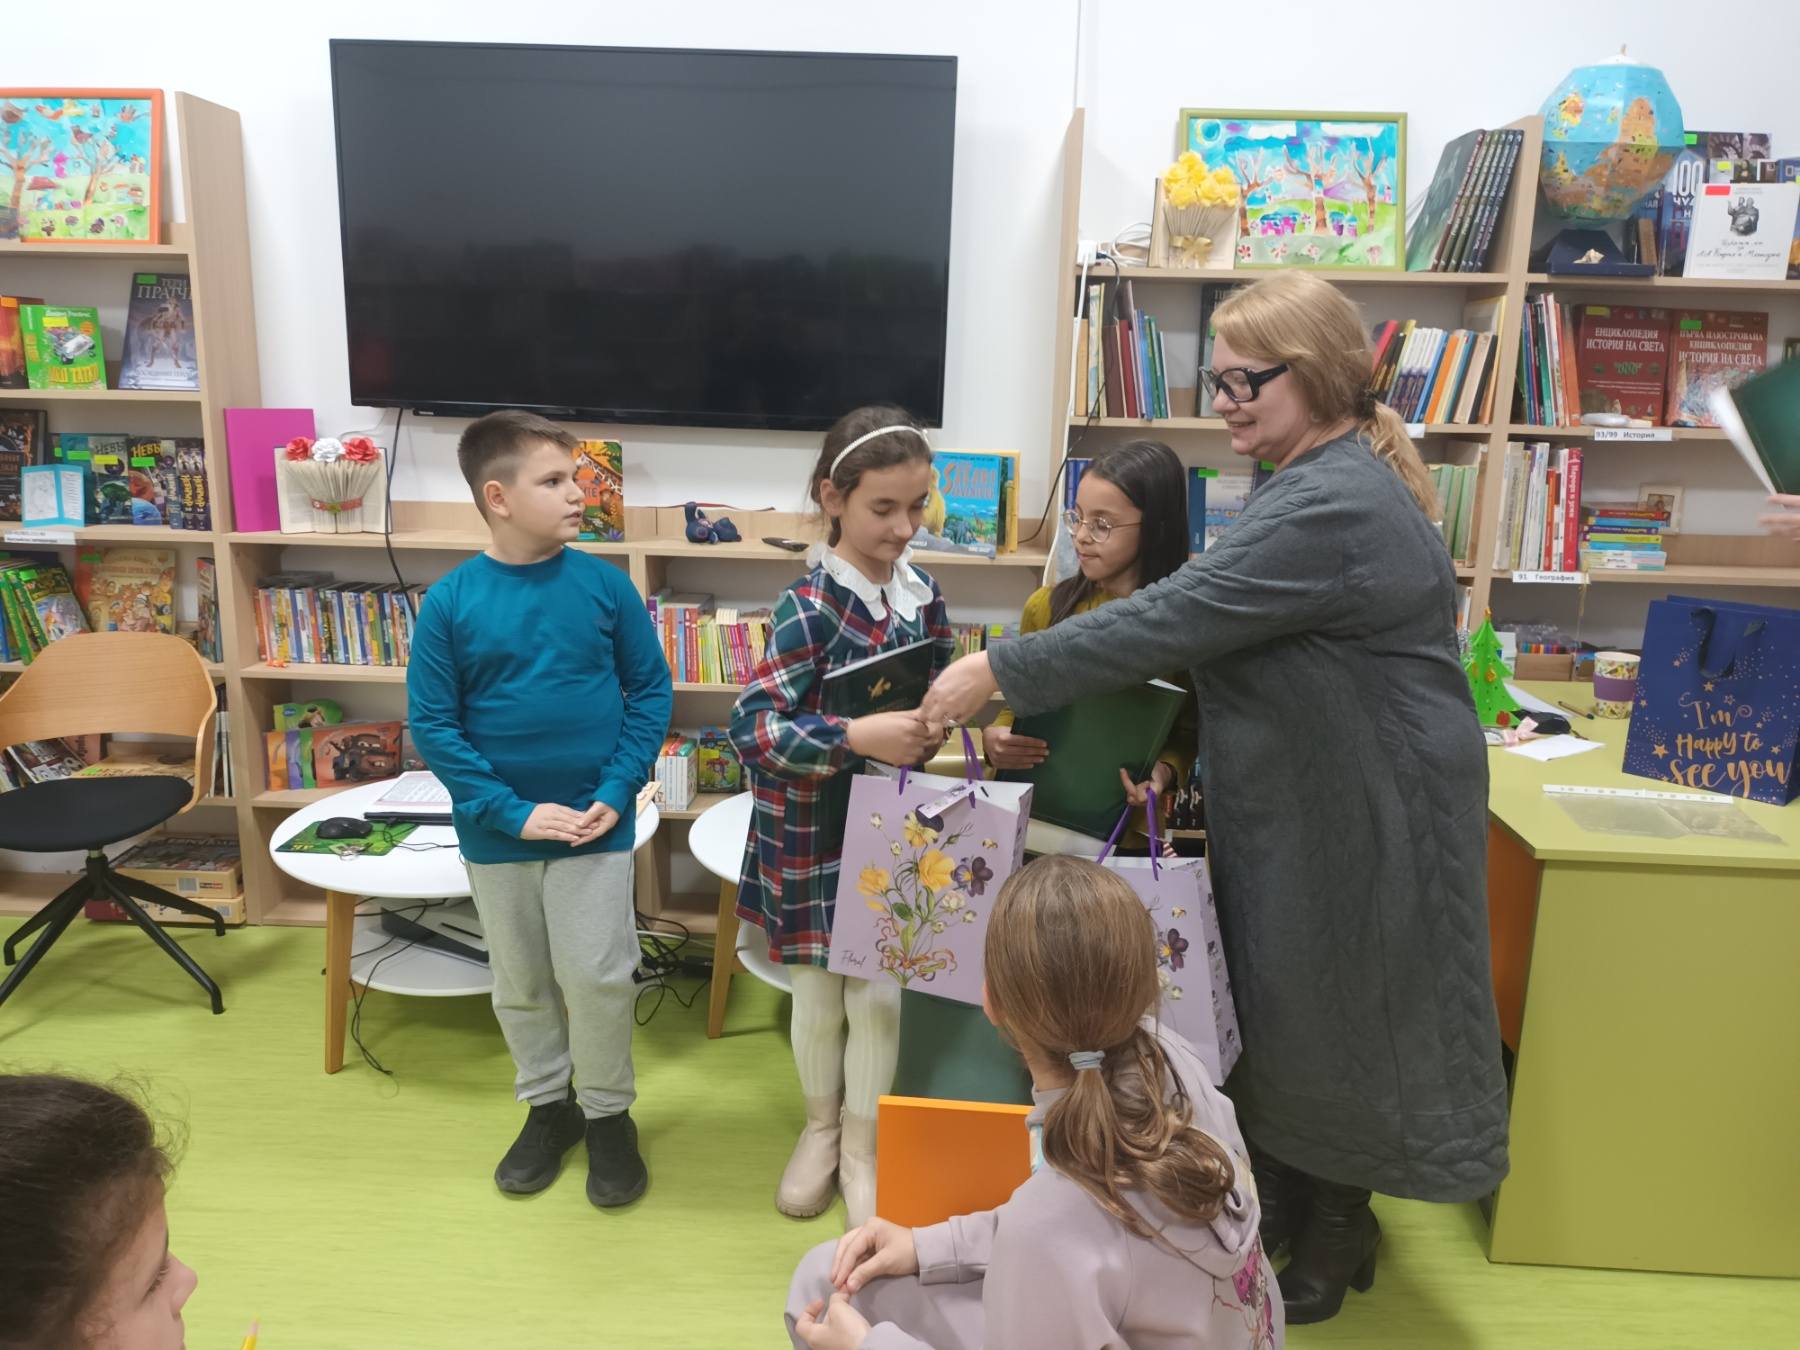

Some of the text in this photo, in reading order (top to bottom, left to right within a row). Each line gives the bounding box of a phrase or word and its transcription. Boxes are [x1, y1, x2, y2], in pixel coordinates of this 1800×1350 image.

[137, 286, 193, 300] ПРАТЧ
[1595, 327, 1659, 339] ЕНЦИКЛОПЕДИЯ
[1586, 339, 1665, 352] ИСТОРИЯ НА СВЕТА
[1678, 351, 1763, 366] ИСТОРИЯ НА СВЕТА
[1596, 431, 1655, 440] 93/99 История
[131, 444, 161, 458] НЕВЪ
[1535, 574, 1576, 582] География
[1675, 731, 1764, 760] Happy to
[1726, 759, 1792, 798] you
